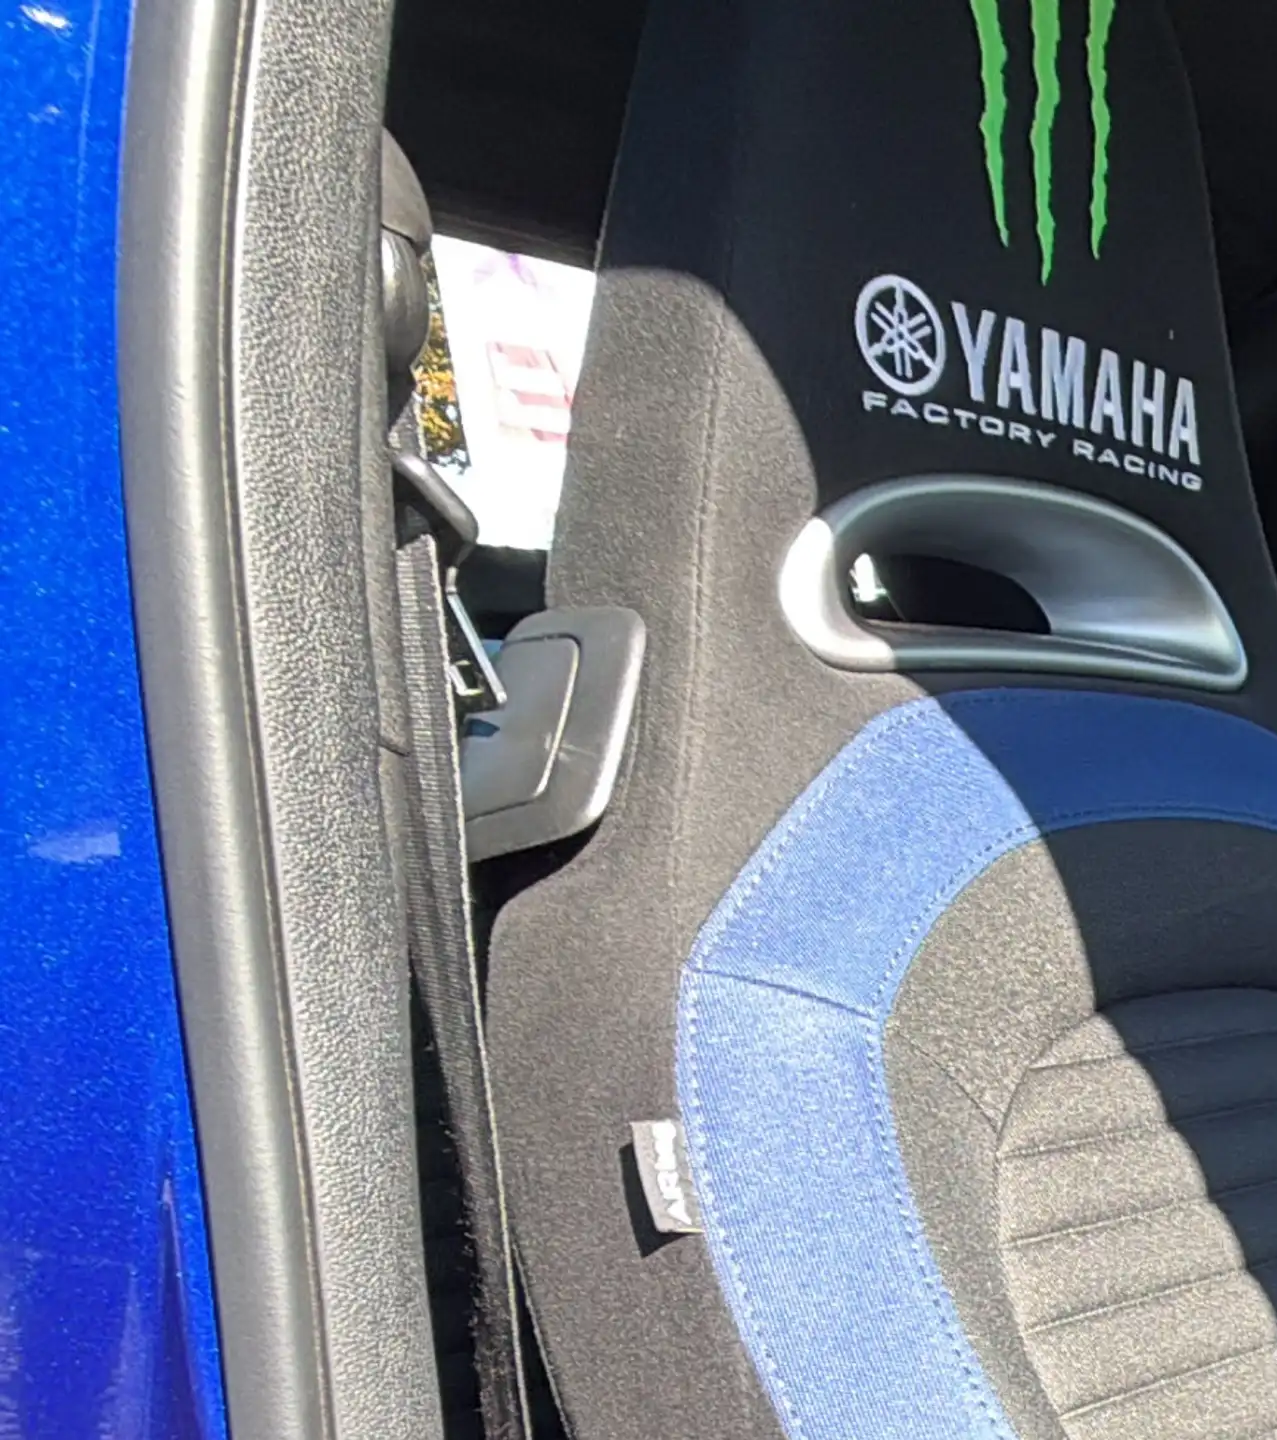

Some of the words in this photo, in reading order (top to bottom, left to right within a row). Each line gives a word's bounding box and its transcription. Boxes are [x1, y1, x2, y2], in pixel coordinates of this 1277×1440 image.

[862, 390, 1057, 450] FACTORY
[1072, 438, 1204, 492] RACING
[951, 301, 1200, 465] YAMAHA
